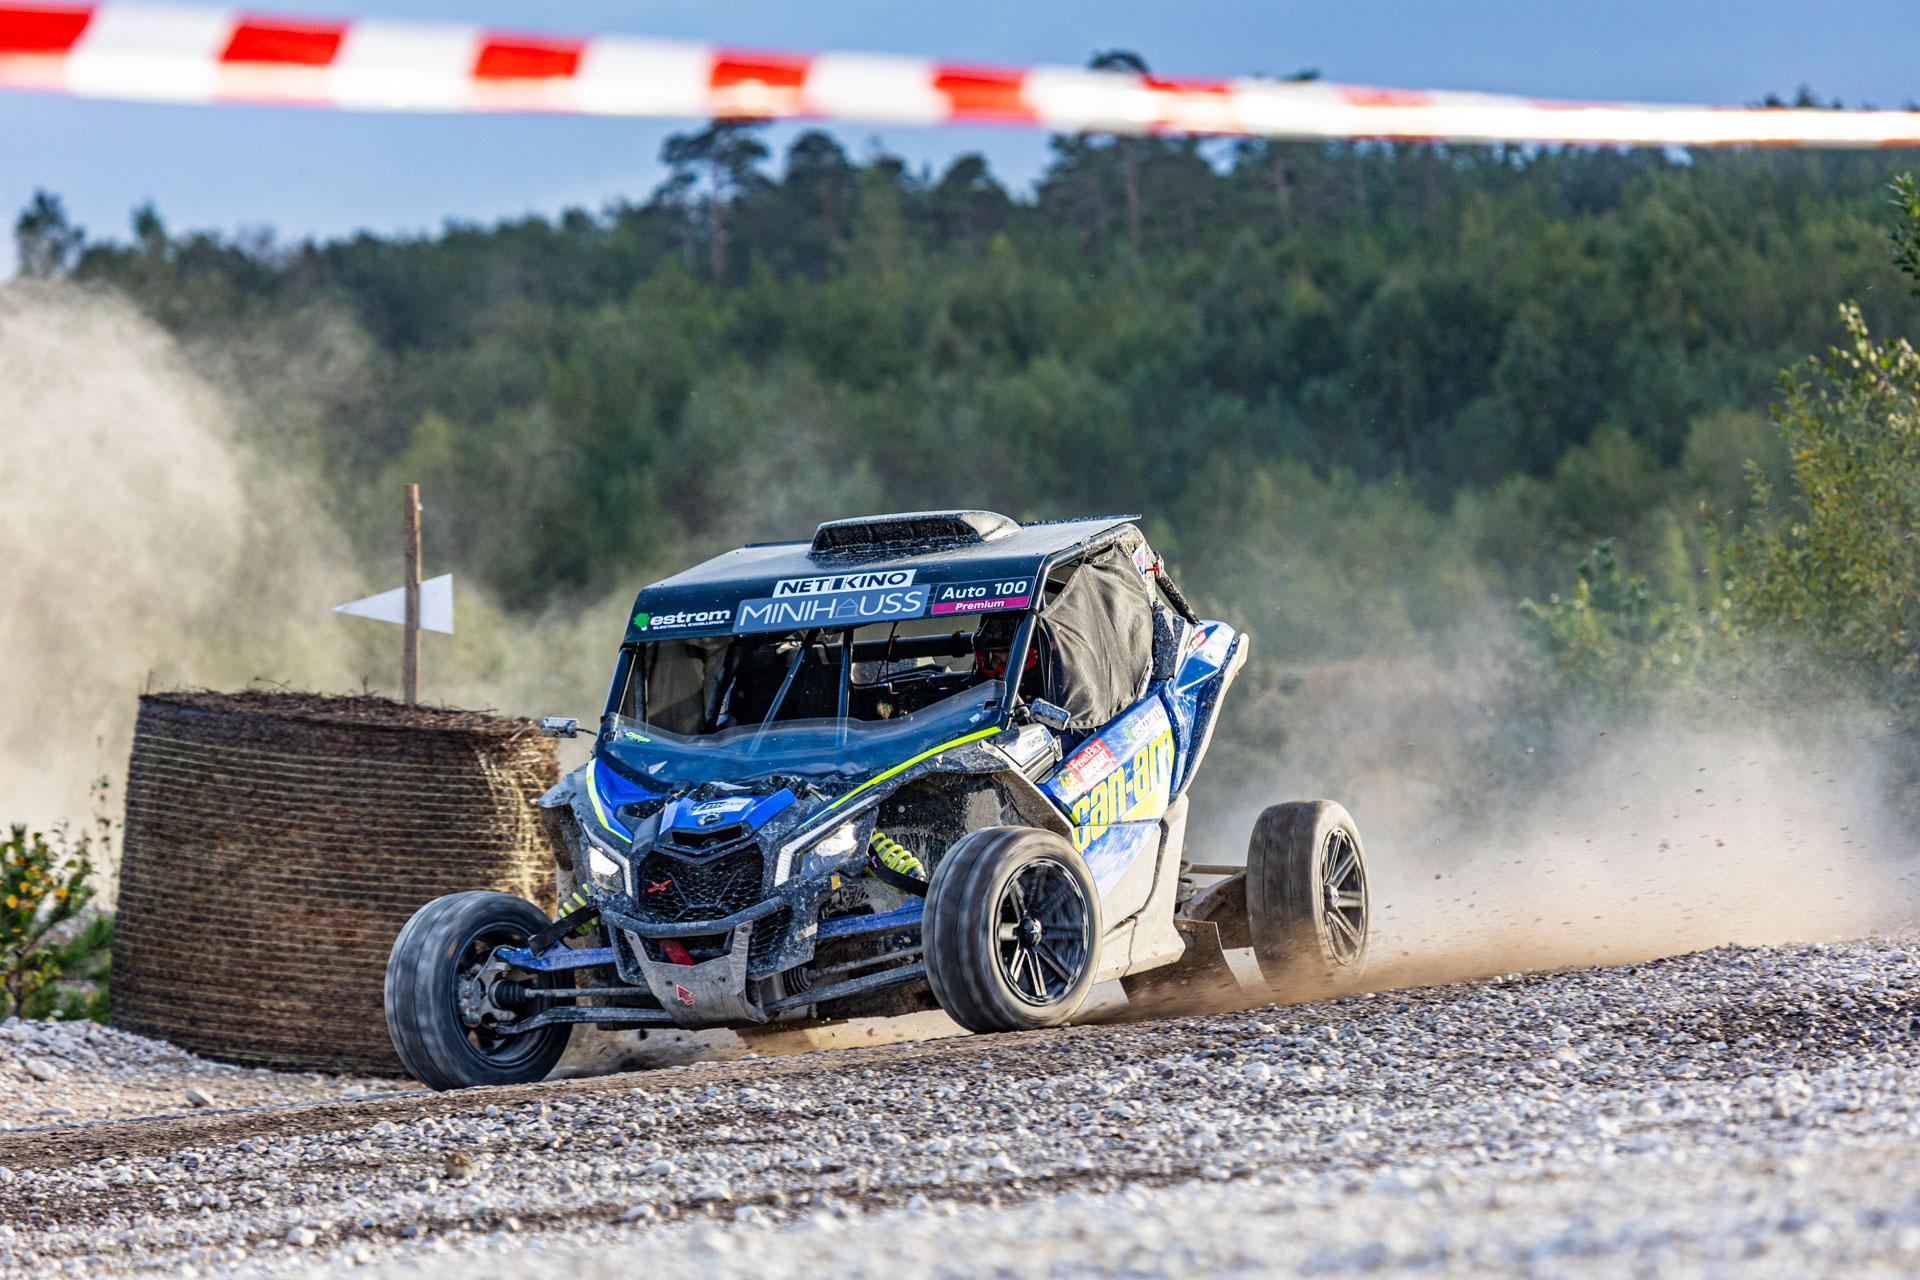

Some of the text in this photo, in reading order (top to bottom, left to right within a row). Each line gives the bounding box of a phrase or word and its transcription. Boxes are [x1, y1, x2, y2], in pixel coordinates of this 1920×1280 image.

[940, 580, 1027, 600] Auto 100
[955, 600, 1005, 611] Premium
[650, 609, 731, 626] estrom
[1071, 728, 1175, 853] can-am
